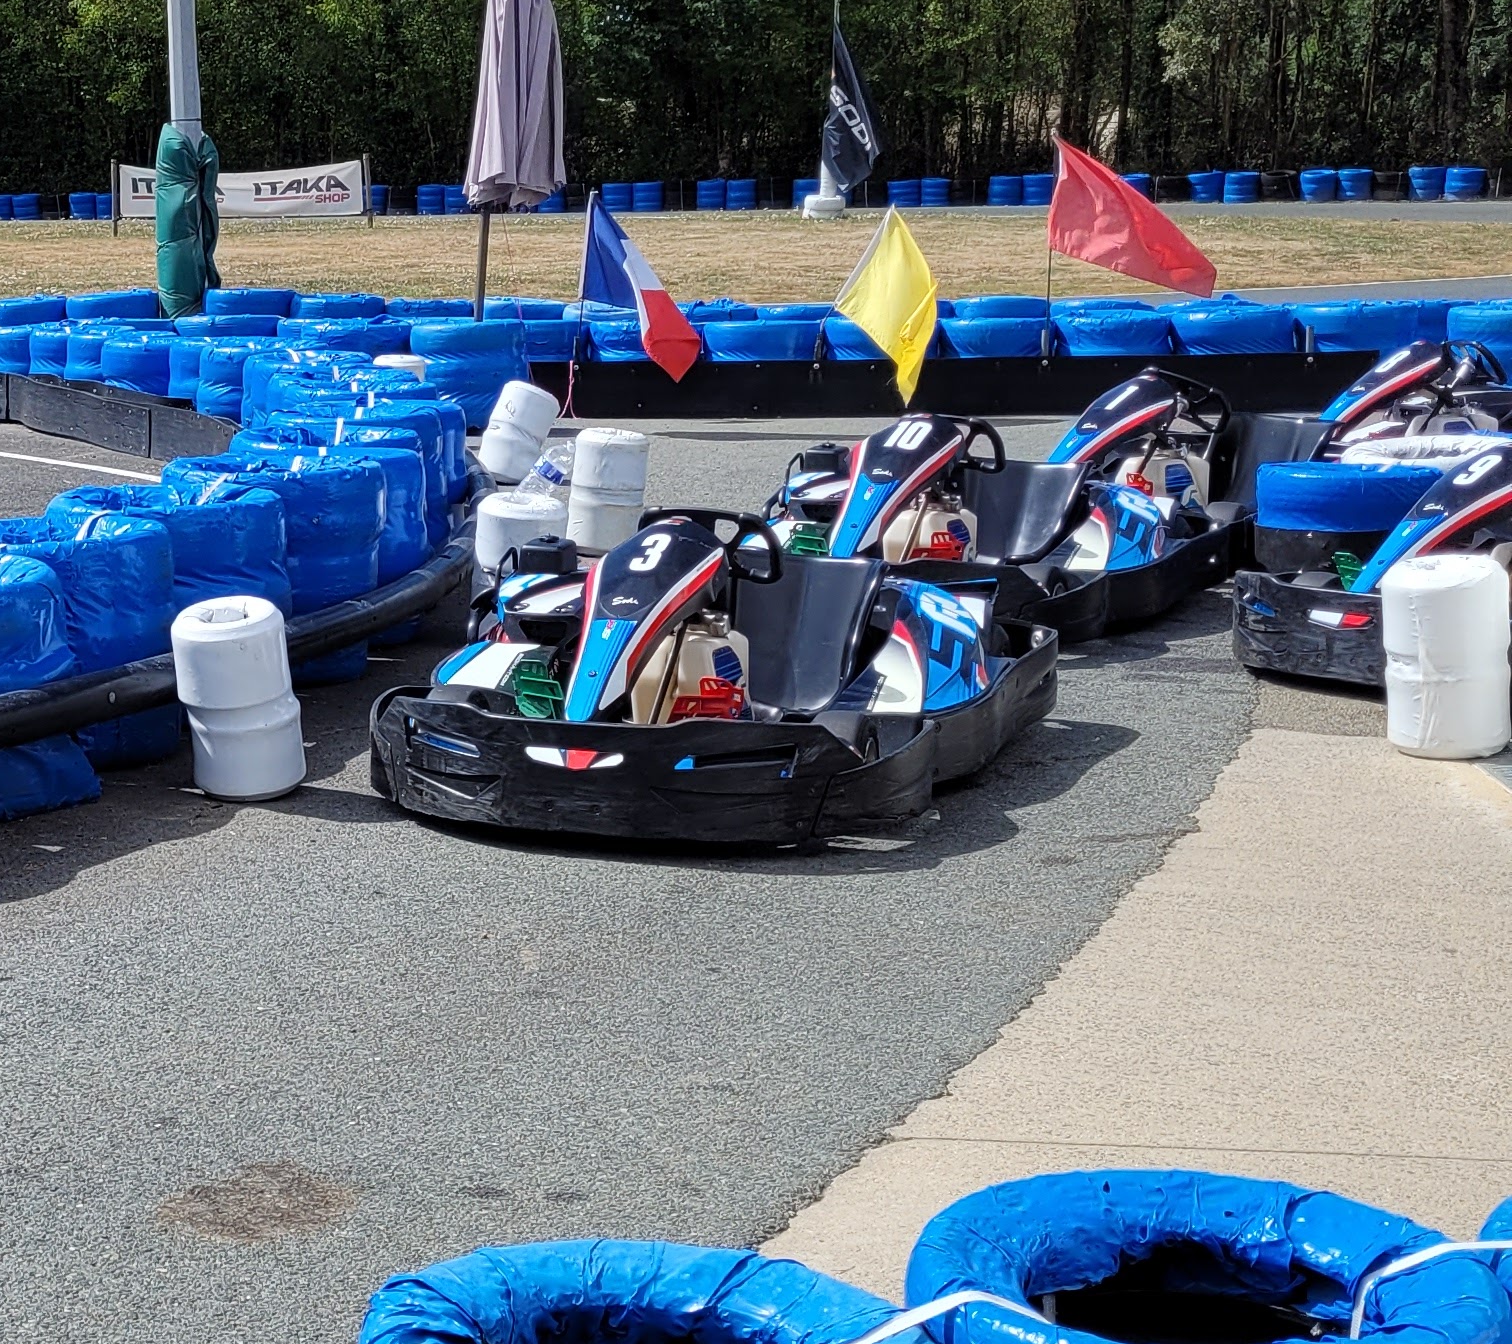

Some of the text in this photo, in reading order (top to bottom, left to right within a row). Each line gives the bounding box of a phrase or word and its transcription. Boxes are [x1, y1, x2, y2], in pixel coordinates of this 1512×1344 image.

[253, 174, 351, 196] ITAKA
[315, 193, 351, 204] SHOP
[1374, 349, 1411, 374] 8
[1104, 385, 1140, 411] 1
[883, 421, 932, 450] 10
[1452, 454, 1503, 485] 9
[629, 533, 673, 572] 3
